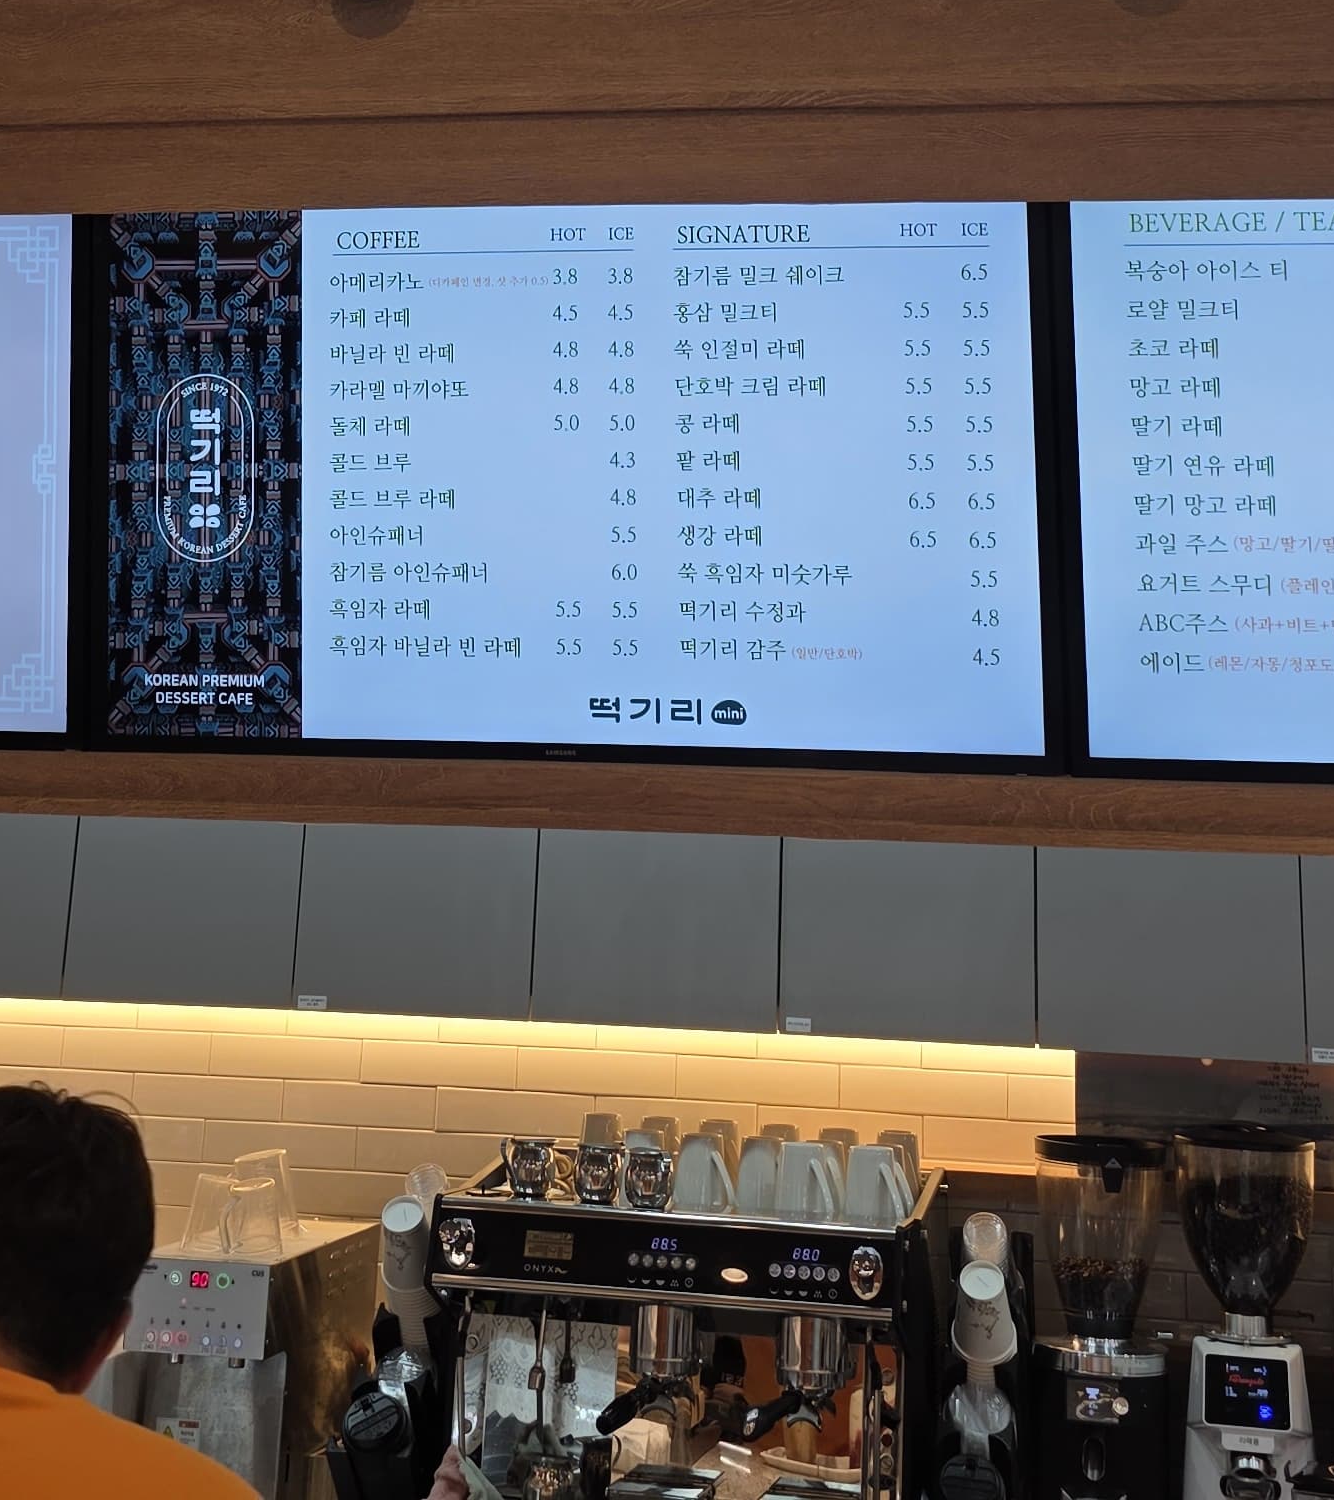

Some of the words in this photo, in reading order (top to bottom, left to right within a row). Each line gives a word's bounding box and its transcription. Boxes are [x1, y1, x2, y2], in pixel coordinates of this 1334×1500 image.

[678, 224, 810, 244] SIGNATURE
[899, 223, 937, 236] HOT
[962, 223, 988, 236] ICE
[1129, 212, 1267, 232] BEVERAGE
[337, 230, 420, 250] COFFEE
[550, 228, 586, 241] HOT
[609, 227, 634, 241] ICE
[674, 266, 733, 287] 참기름
[738, 265, 780, 286] 밀크
[785, 265, 845, 286] 쉐이크
[961, 264, 987, 281] 6.5
[1125, 260, 1190, 282] 복숭아
[1197, 260, 1261, 282] 아이스
[1269, 259, 1287, 281] 티
[330, 308, 368, 329] 카페
[372, 308, 409, 328] 라떼
[553, 305, 577, 321] 4.5
[608, 304, 633, 321] 4.5
[1127, 299, 1169, 320] 로얄
[1177, 299, 1238, 321] 밀크티
[330, 344, 387, 364] 바닐라
[391, 343, 410, 363] 빈
[419, 343, 453, 364] 라떼
[553, 341, 578, 358] 4.8
[608, 341, 634, 357] 4.8
[180, 382, 208, 398] SINCE
[210, 382, 229, 397] 1972
[330, 380, 388, 401] 카라멜
[391, 379, 469, 400] 마끼야또
[553, 378, 578, 395] 4.8
[609, 377, 634, 395] 4.8
[675, 376, 734, 396] 단호박
[741, 376, 777, 396] 크림
[788, 376, 825, 397] 라떼
[905, 378, 931, 395] 5.5
[964, 377, 991, 395] 5.5
[329, 416, 368, 436] 돌체
[372, 416, 409, 436] 라떼
[554, 414, 579, 431] 5.0
[609, 414, 635, 431] 5.0
[189, 407, 221, 496] 떡기리
[1134, 493, 1173, 516] 딸기
[1184, 494, 1227, 516] 망고
[1235, 495, 1275, 516] 라떼
[330, 525, 422, 546] 아인슈패너
[611, 526, 636, 543] 5.5
[330, 561, 388, 583] 참기름
[391, 562, 487, 584] 아인슈패너
[612, 564, 637, 580] 6.0
[677, 563, 698, 584] 쑥
[704, 563, 765, 585] 흑임자
[772, 564, 853, 586] 미숫가루
[971, 570, 997, 588] 5.5
[679, 600, 736, 623] 떡기리
[745, 601, 806, 623] 수정과
[971, 609, 999, 627] 4.8
[1139, 613, 1228, 635] ABC주스
[329, 635, 389, 657] 흑임자
[392, 636, 454, 658] 바닐라
[457, 637, 475, 657] 빈
[483, 637, 520, 659] 라떼
[556, 638, 581, 655] 5.5
[613, 639, 638, 656] 5.5
[680, 638, 736, 660] 떡기리
[747, 639, 786, 661] 감주
[973, 648, 1000, 666] 4.5
[144, 674, 198, 687] KOREAN
[202, 674, 265, 688] PREMIUM
[155, 691, 216, 705] DESSERT
[218, 693, 254, 706] CAFE
[589, 697, 702, 725] 떡기리
[714, 708, 744, 720] mini
[523, 1263, 554, 1273] ONYX
[191, 1272, 209, 1288] 90
